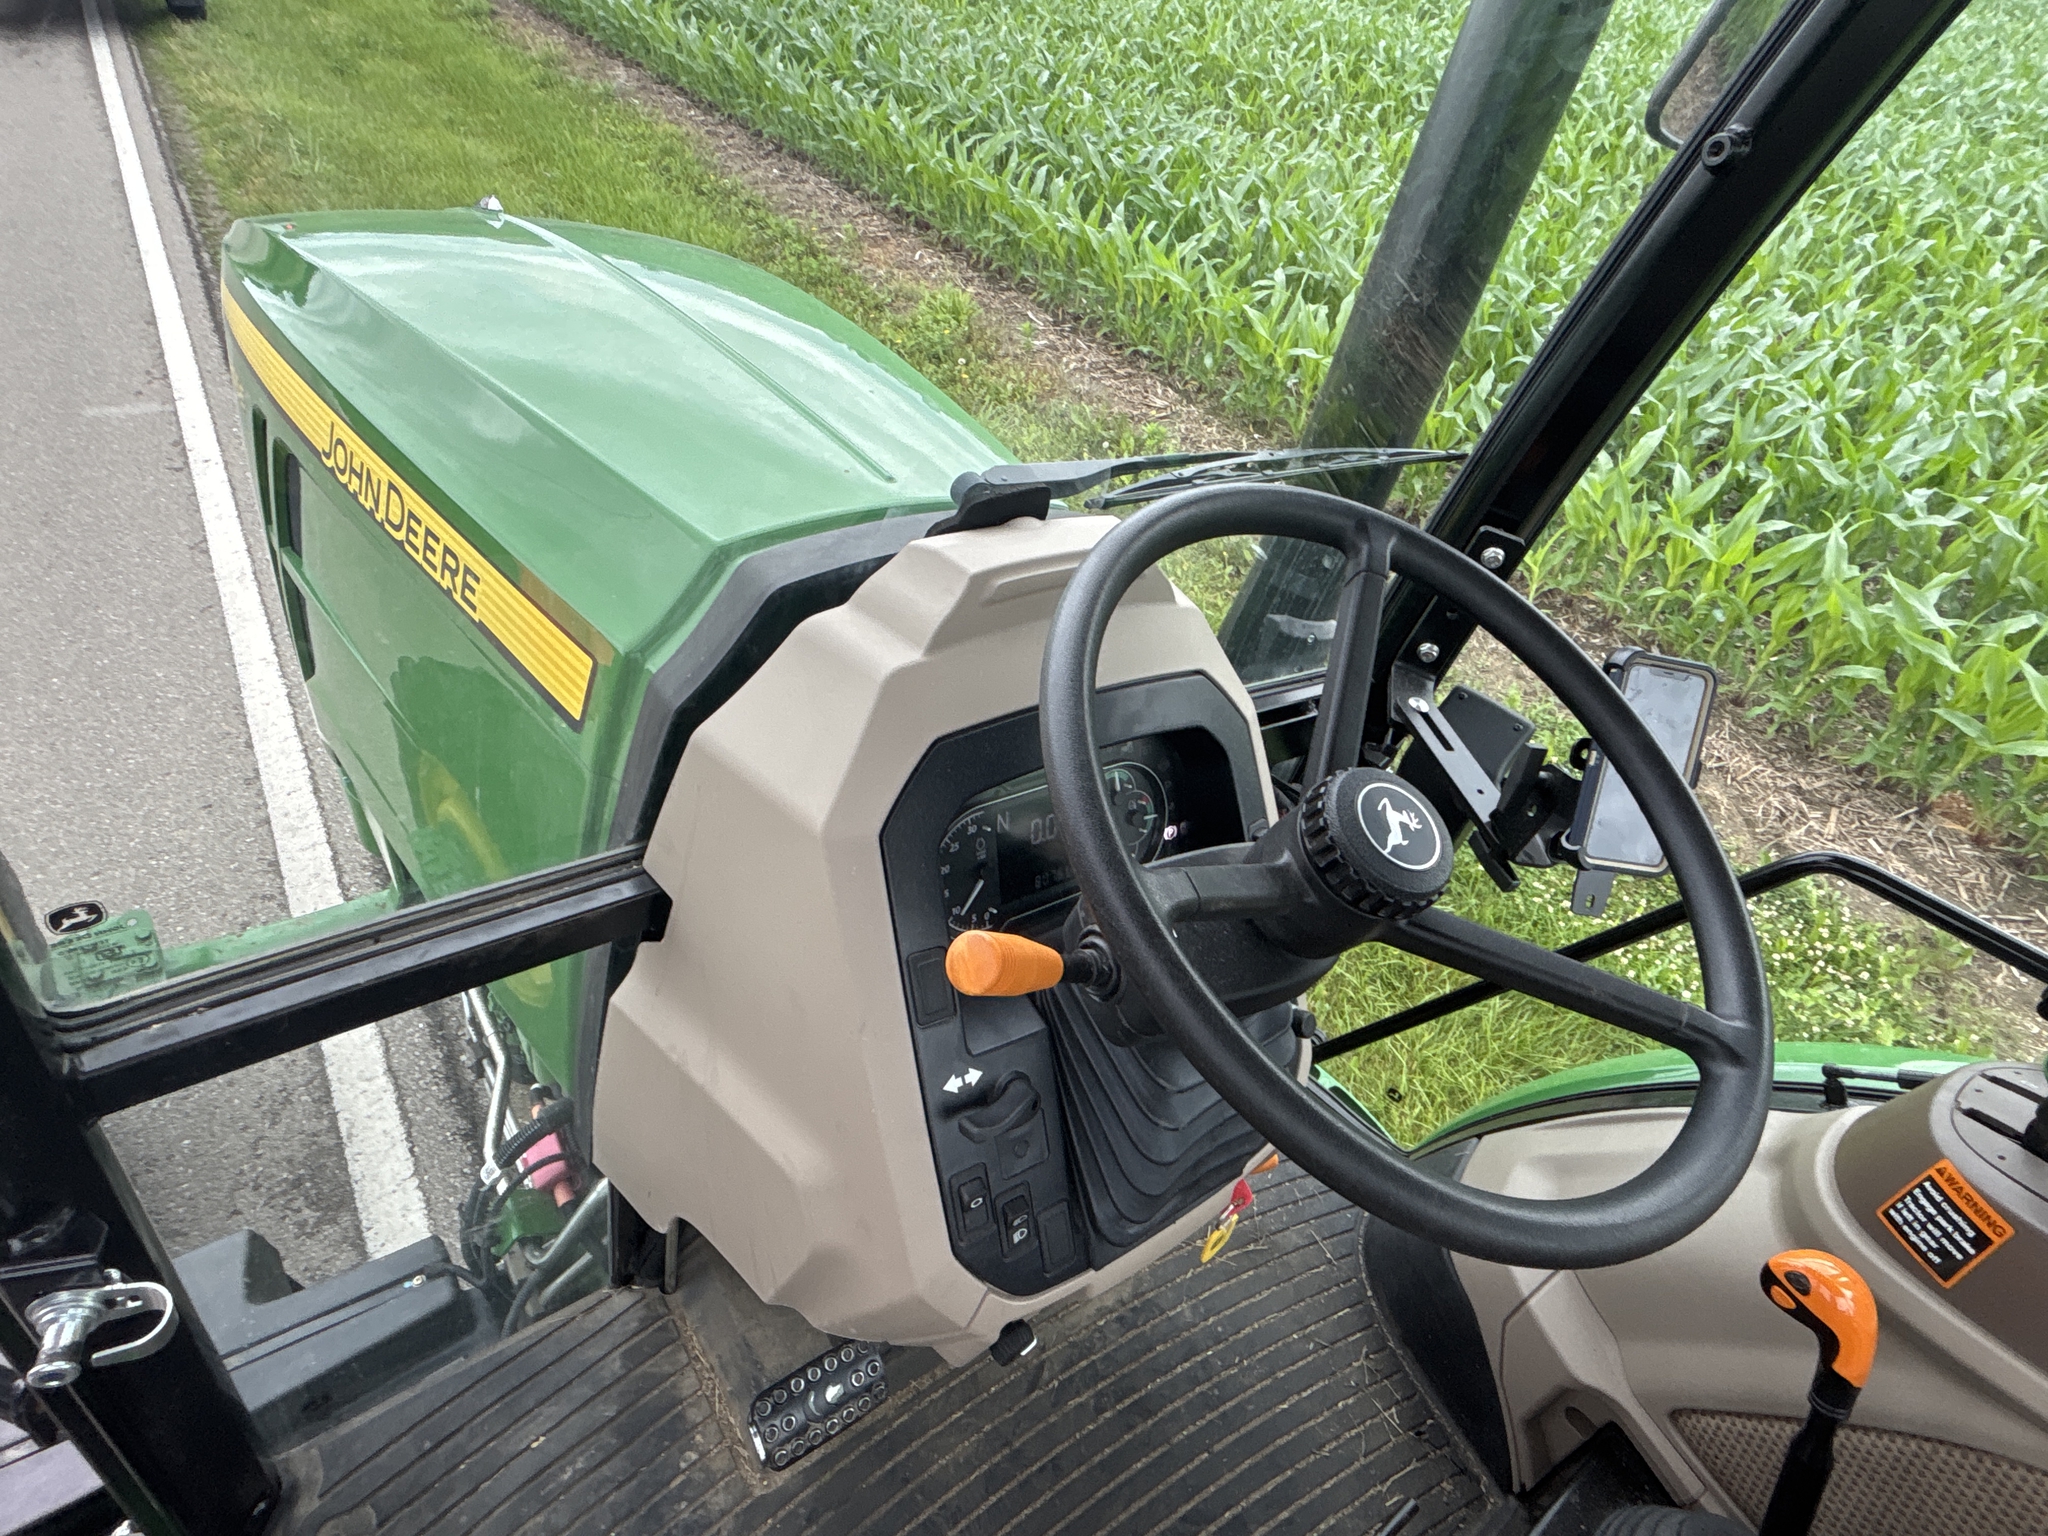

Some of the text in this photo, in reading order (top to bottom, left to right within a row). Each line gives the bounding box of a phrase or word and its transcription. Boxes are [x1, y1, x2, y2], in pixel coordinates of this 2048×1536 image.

[321, 420, 481, 613] JOHN DEERE
[997, 811, 1010, 833] N
[1904, 1195, 1964, 1261] Tractor will move
[1912, 1187, 1938, 1216] Engage
[1934, 1215, 1954, 1233] park
[1922, 1181, 1976, 1238] Avoid crushing
[1944, 1173, 2006, 1238] WARNING
[1888, 1208, 1942, 1264] with engine off
[1912, 1222, 1922, 1231] in
[1919, 1231, 1940, 1249] gear
